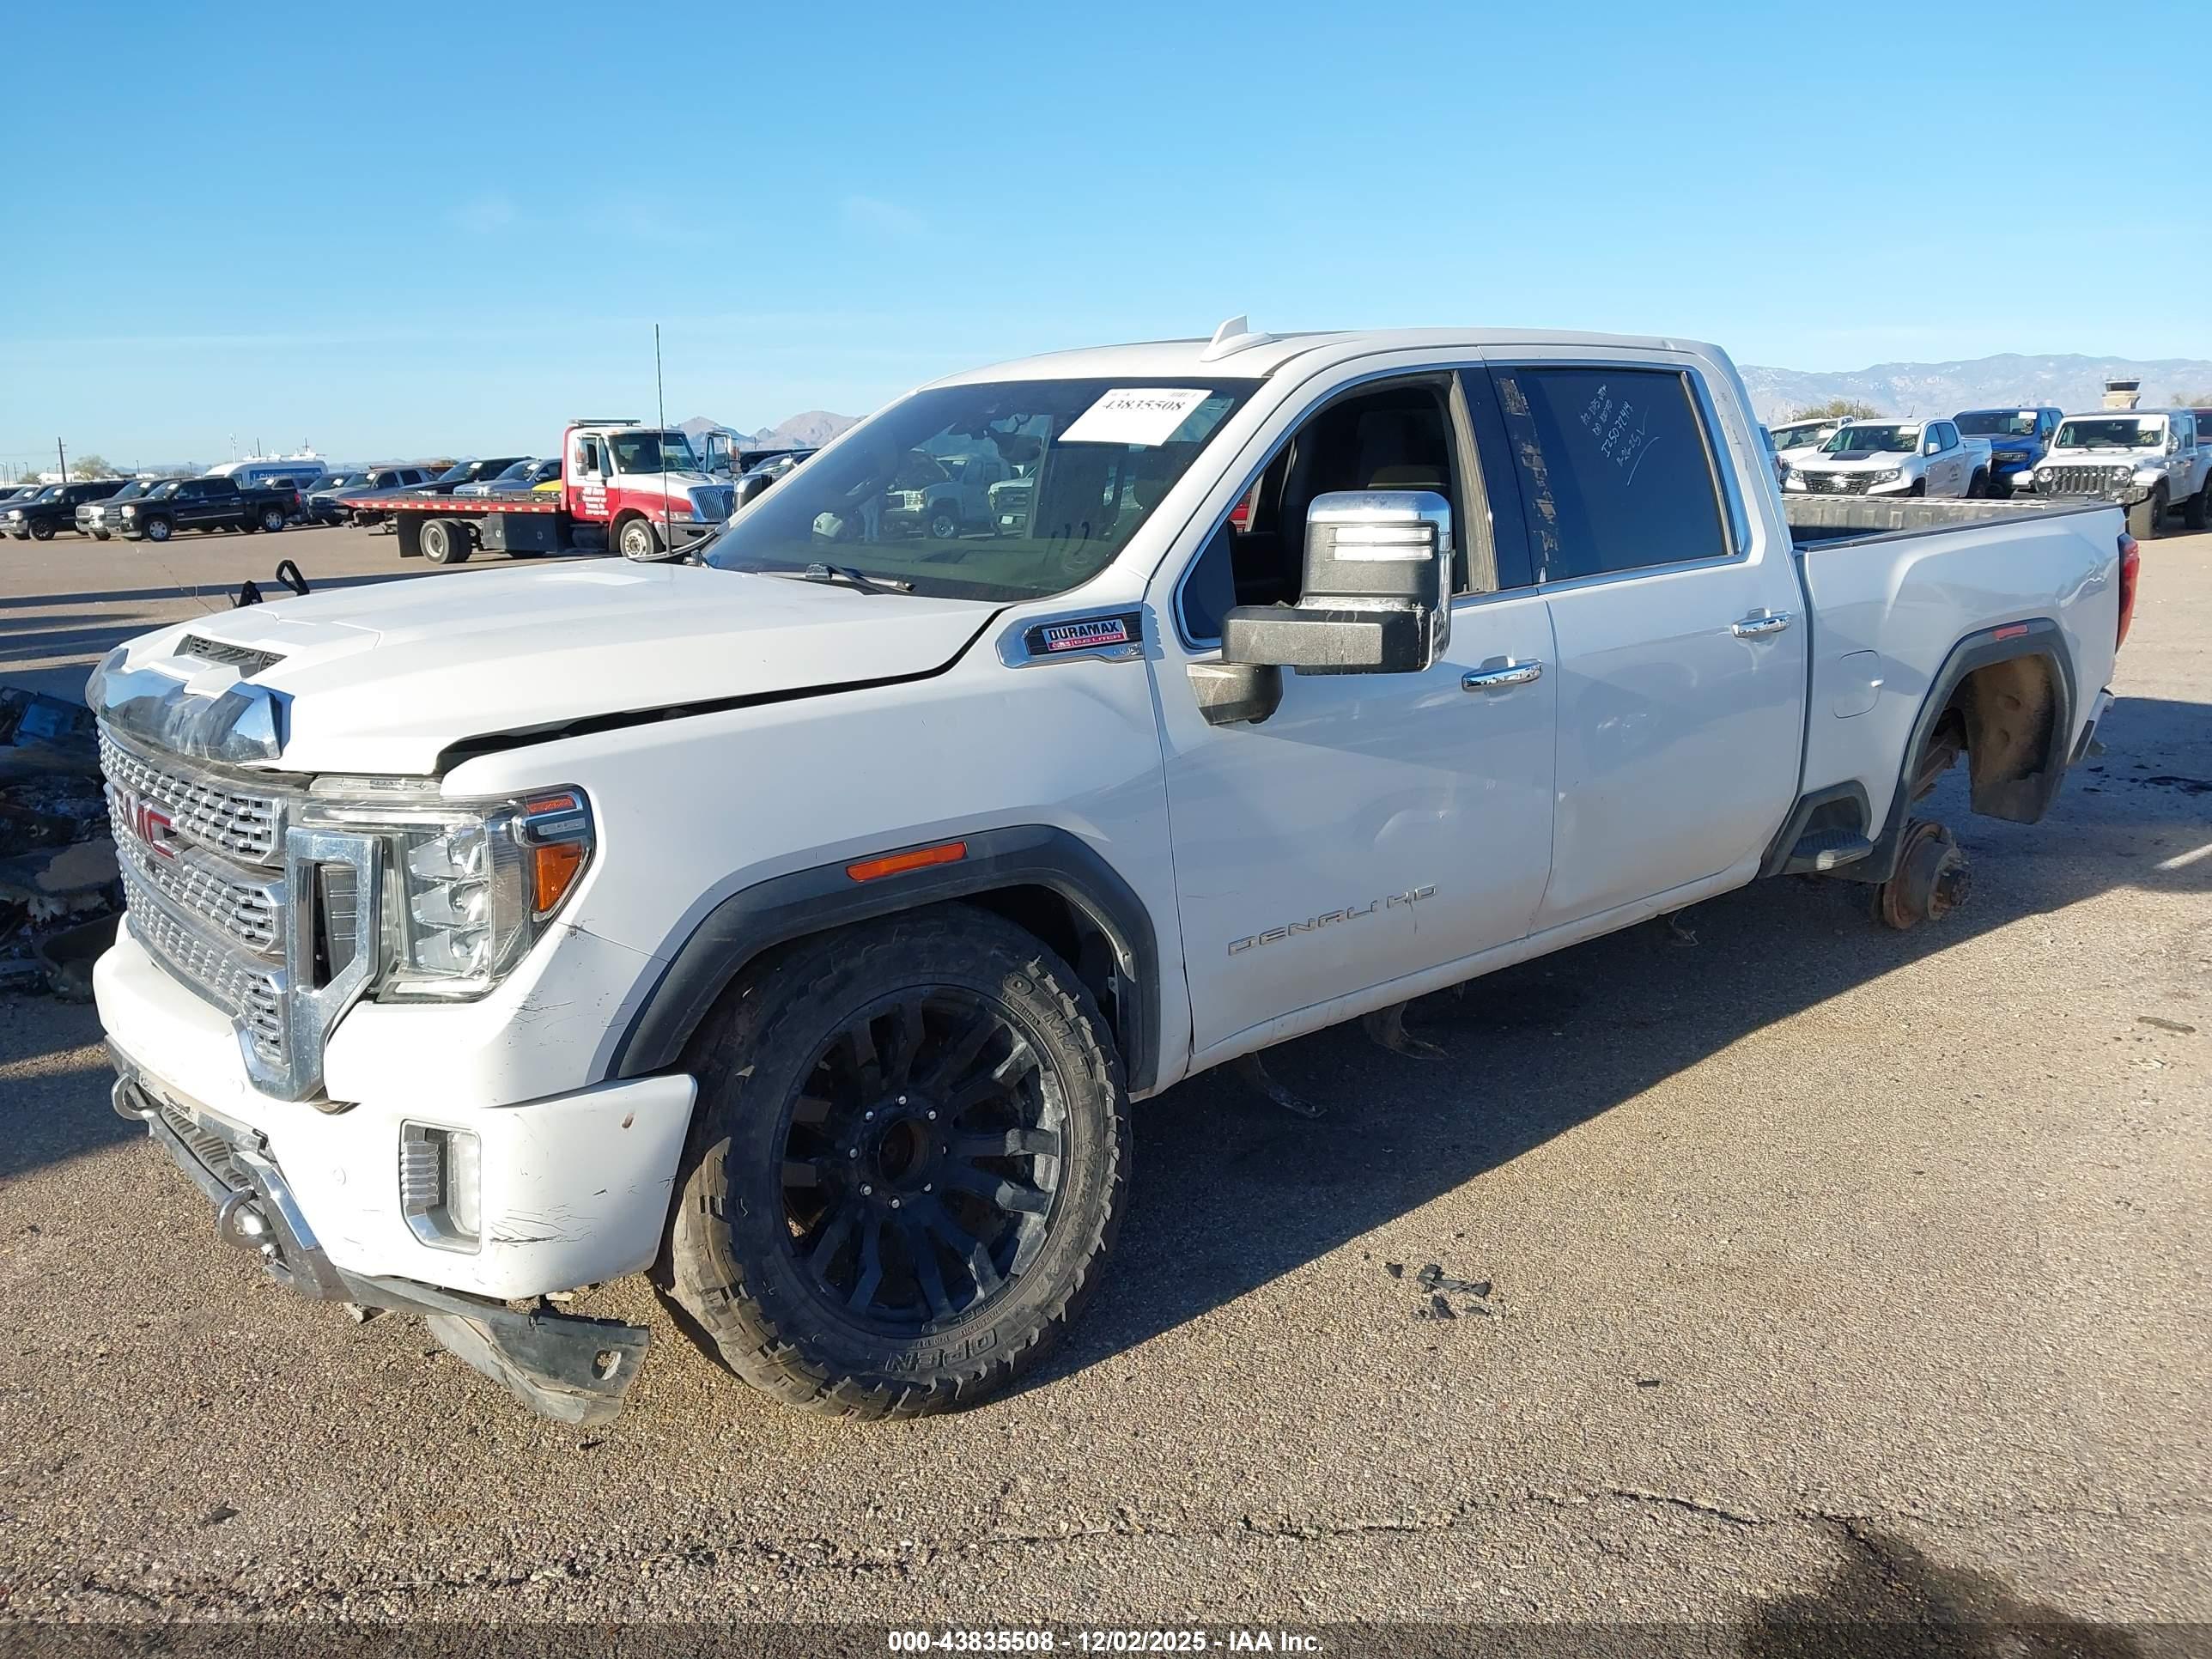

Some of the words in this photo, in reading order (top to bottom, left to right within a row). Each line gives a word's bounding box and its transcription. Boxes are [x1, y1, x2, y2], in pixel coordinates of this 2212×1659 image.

[1103, 398, 1186, 411] 43835508
[1048, 622, 1119, 641] DURAMAX
[1228, 899, 1378, 956] DENALI
[1387, 884, 1437, 909] HD
[884, 1328, 997, 1373] OPEN
